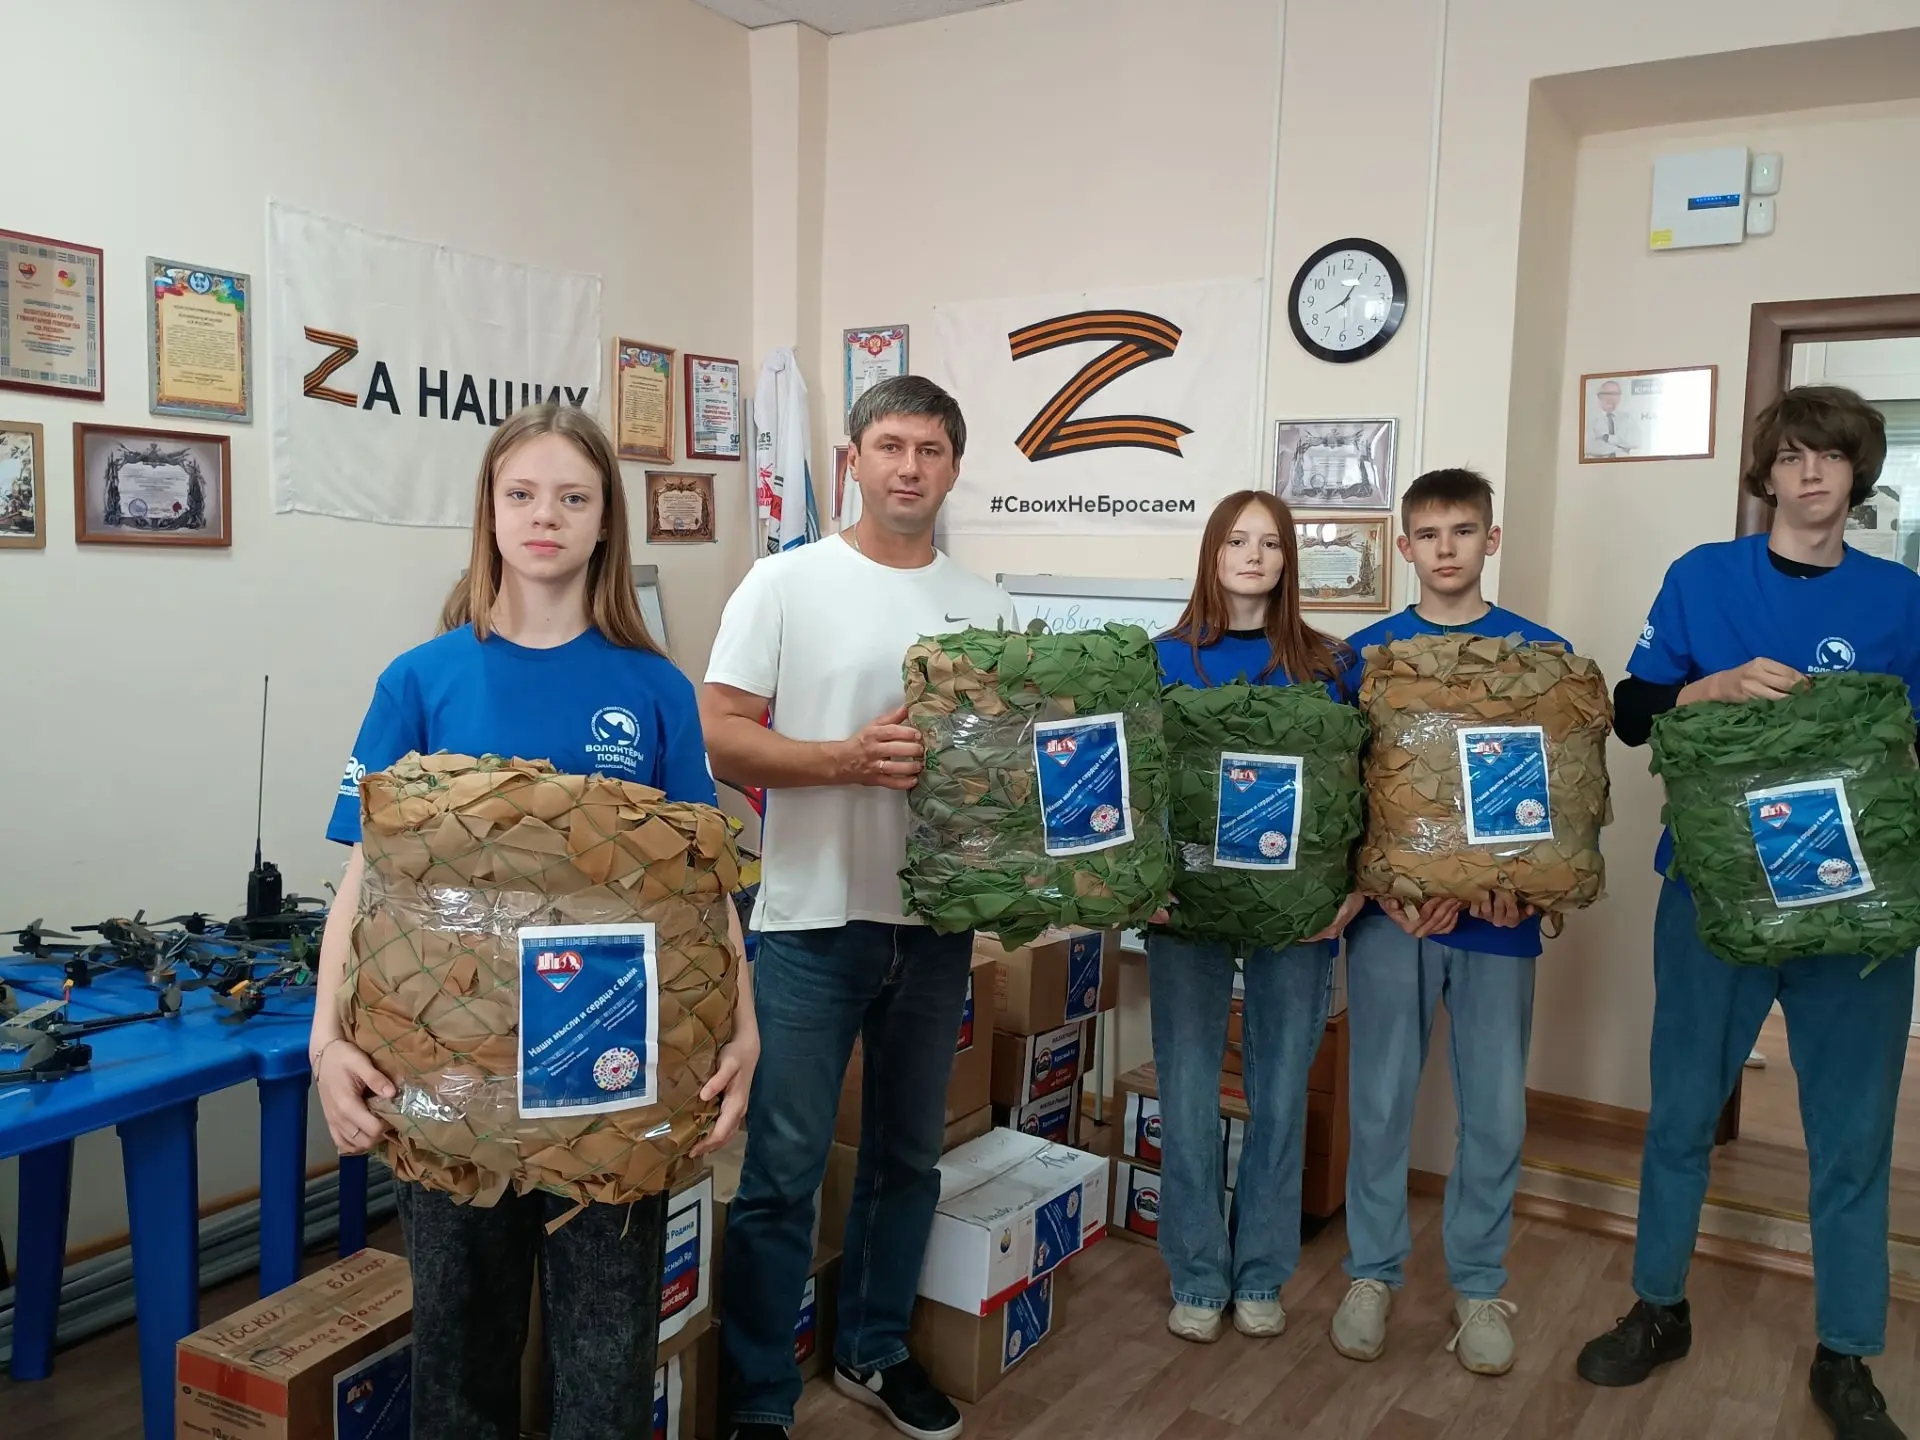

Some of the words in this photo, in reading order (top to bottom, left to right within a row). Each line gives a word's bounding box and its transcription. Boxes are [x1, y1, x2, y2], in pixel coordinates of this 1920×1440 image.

[1343, 258, 1354, 270] 12
[1364, 263, 1368, 274] 1
[1327, 265, 1336, 276] 11
[1314, 278, 1325, 290] 10
[1374, 275, 1381, 287] 2
[1307, 295, 1315, 308] 9
[1311, 313, 1319, 325] 8
[1324, 326, 1331, 337] 7
[1339, 329, 1347, 342] 6
[1356, 325, 1364, 337] 5
[1008, 310, 1195, 463] Z
[990, 495, 1195, 517] #СвоихНеБросаем
[597, 753, 637, 768] ПОБЕДЫ
[528, 1037, 554, 1057] Наши
[552, 1016, 581, 1041] мысли
[586, 988, 614, 1014] сердца
[617, 967, 638, 987] Вами
[671, 1221, 694, 1239] Родина
